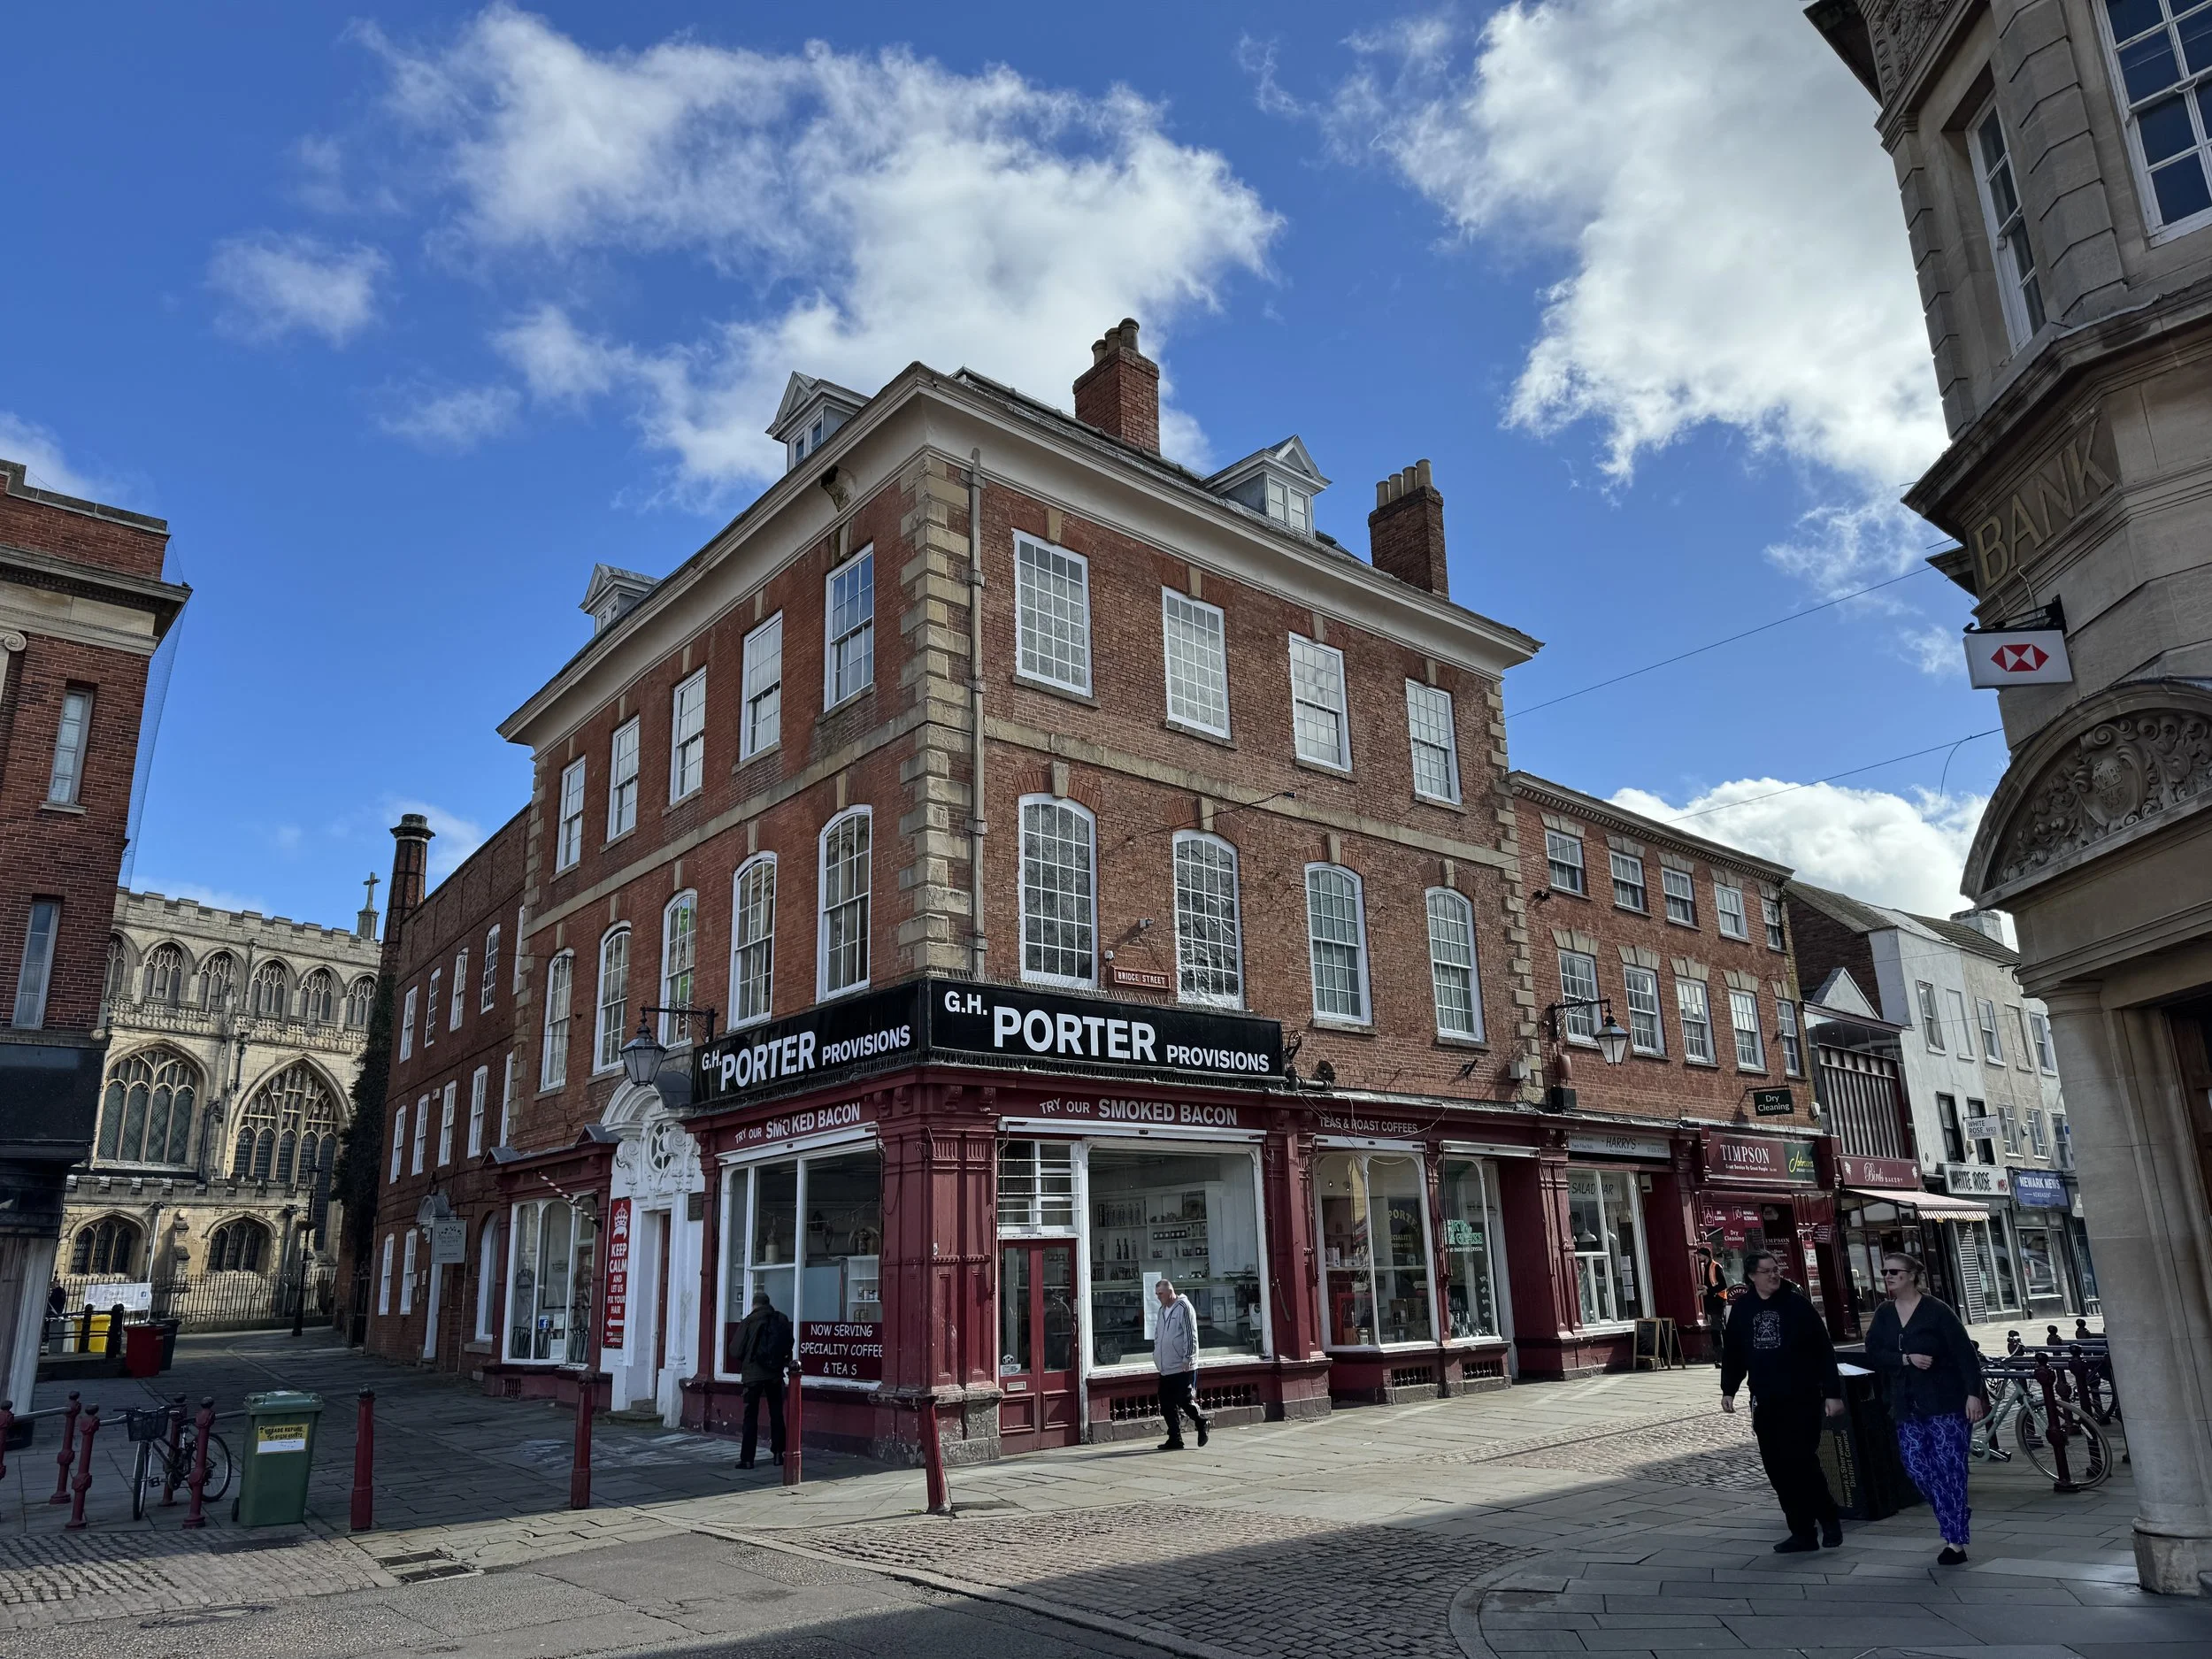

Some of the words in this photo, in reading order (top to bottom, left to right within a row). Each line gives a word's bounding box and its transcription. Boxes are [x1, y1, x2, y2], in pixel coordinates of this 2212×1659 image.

[1973, 418, 2115, 591] BANK
[1118, 971, 1140, 984] BRIDGE
[1141, 973, 1165, 986] STREET
[944, 990, 988, 1016] G.H.
[994, 1005, 1157, 1062] PORTER
[1166, 1044, 1270, 1072] PROVISIONS
[702, 1049, 722, 1071] G.H.
[720, 1031, 816, 1092] PORTER
[822, 1025, 911, 1066] PROVISIONS
[1040, 1097, 1061, 1115] TRY
[1066, 1101, 1090, 1114] OUR
[1098, 1098, 1175, 1122] SMOKED
[1179, 1103, 1237, 1125] BACON
[1758, 1103, 1790, 1112] Cleaning
[734, 1127, 747, 1145] TRY
[749, 1126, 762, 1140] OUR
[818, 1102, 861, 1128] BACON
[1319, 1118, 1341, 1128] TEAS
[1343, 1118, 1349, 1129] &
[1351, 1118, 1379, 1131] ROAST
[1381, 1121, 1418, 1133] COFFEES
[1720, 1144, 1770, 1164] TIMPSON
[1571, 1182, 1595, 1194] SALAD
[1949, 1170, 1972, 1192] WHITE
[1972, 1171, 1992, 1192] ROSE
[2019, 1176, 2045, 1188] NEWARK
[2044, 1179, 2061, 1189] NEWS
[611, 1243, 627, 1257] KEEP
[609, 1258, 627, 1273] CALM
[613, 1274, 623, 1283] AND
[618, 1284, 624, 1293] US
[1729, 1288, 1748, 1297] TIMPS
[614, 1295, 626, 1304] YOUR
[810, 1324, 832, 1337] NOW
[833, 1325, 873, 1337] SERVING
[800, 1342, 849, 1356] SPECIALITY
[824, 1362, 829, 1374] &
[1841, 1429, 1852, 1457] Council
[1835, 1435, 1847, 1472] Sherwood
[1847, 1459, 1856, 1487] District
